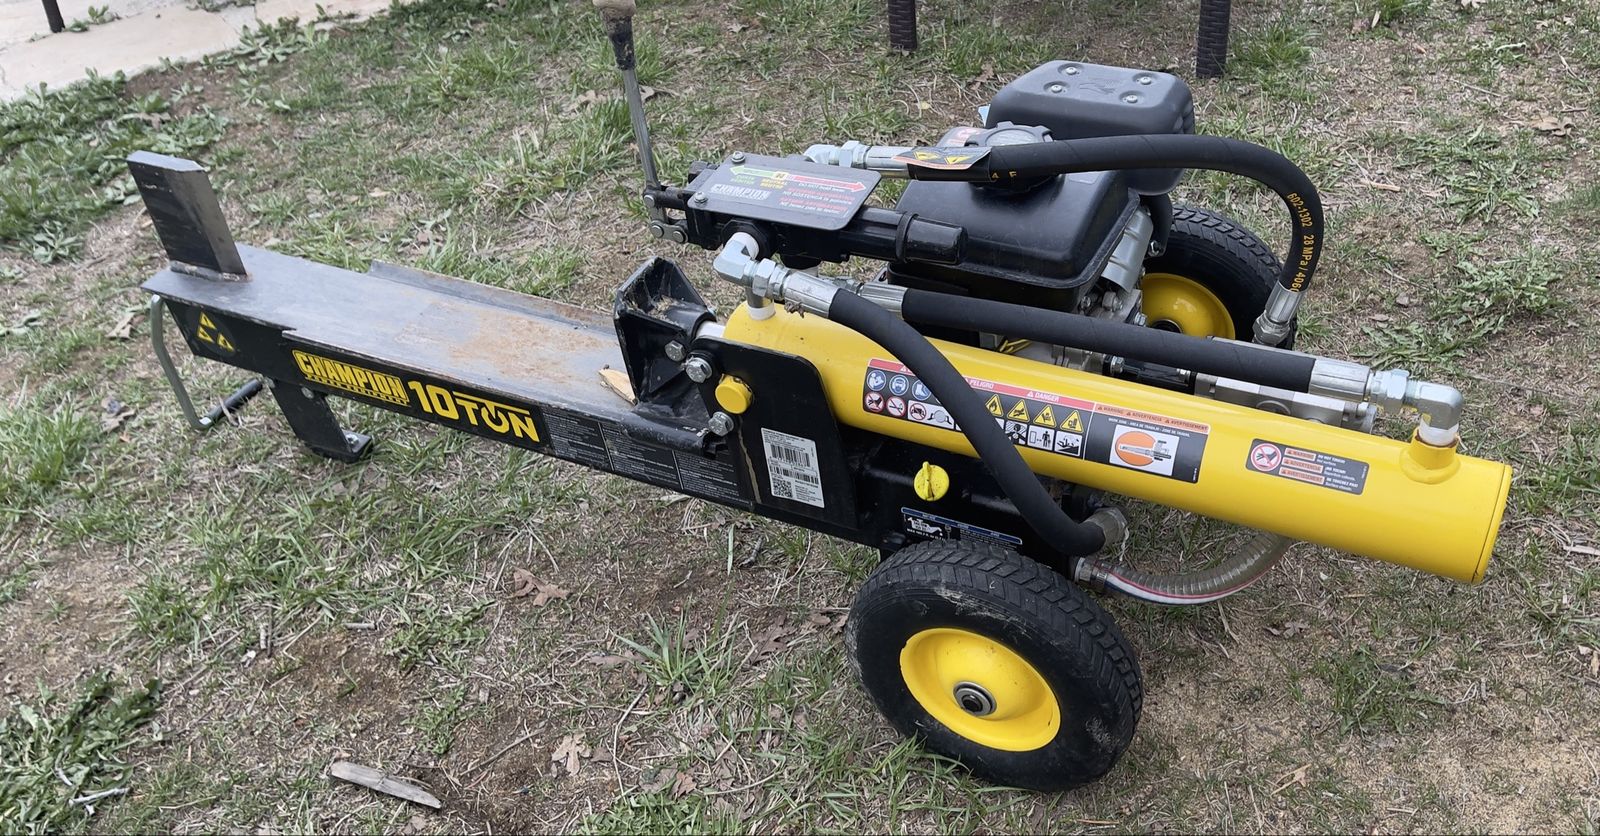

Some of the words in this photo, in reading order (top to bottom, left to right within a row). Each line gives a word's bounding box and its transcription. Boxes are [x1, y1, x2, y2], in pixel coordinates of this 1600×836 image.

[710, 184, 772, 200] CHAMPION
[1287, 192, 1313, 227] 602-1302
[1303, 234, 1315, 246] 28
[299, 353, 408, 399] CHAMPION
[1035, 392, 1060, 402] DANGER
